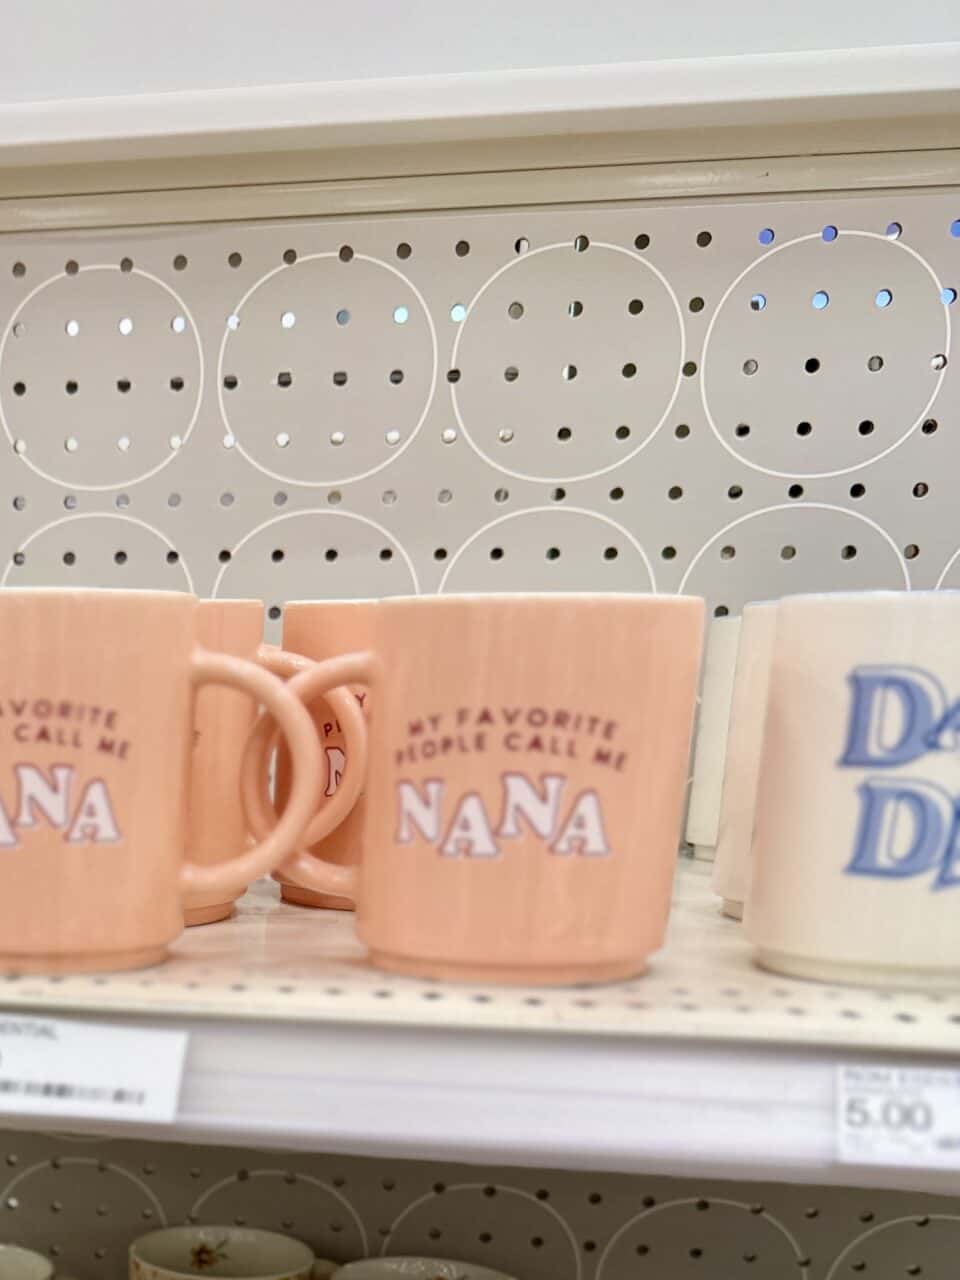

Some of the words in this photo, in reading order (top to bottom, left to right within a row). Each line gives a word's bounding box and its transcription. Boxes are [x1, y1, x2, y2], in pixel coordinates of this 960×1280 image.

[13, 723, 82, 749] CALL
[97, 737, 130, 760] ME
[408, 714, 441, 737] MY
[456, 707, 617, 741] FAVORITE
[395, 731, 487, 766] PEOPLE
[502, 732, 578, 759] CALL
[593, 747, 627, 772] ME
[395, 770, 611, 858] NANA
[845, 1096, 935, 1132] 5.00
